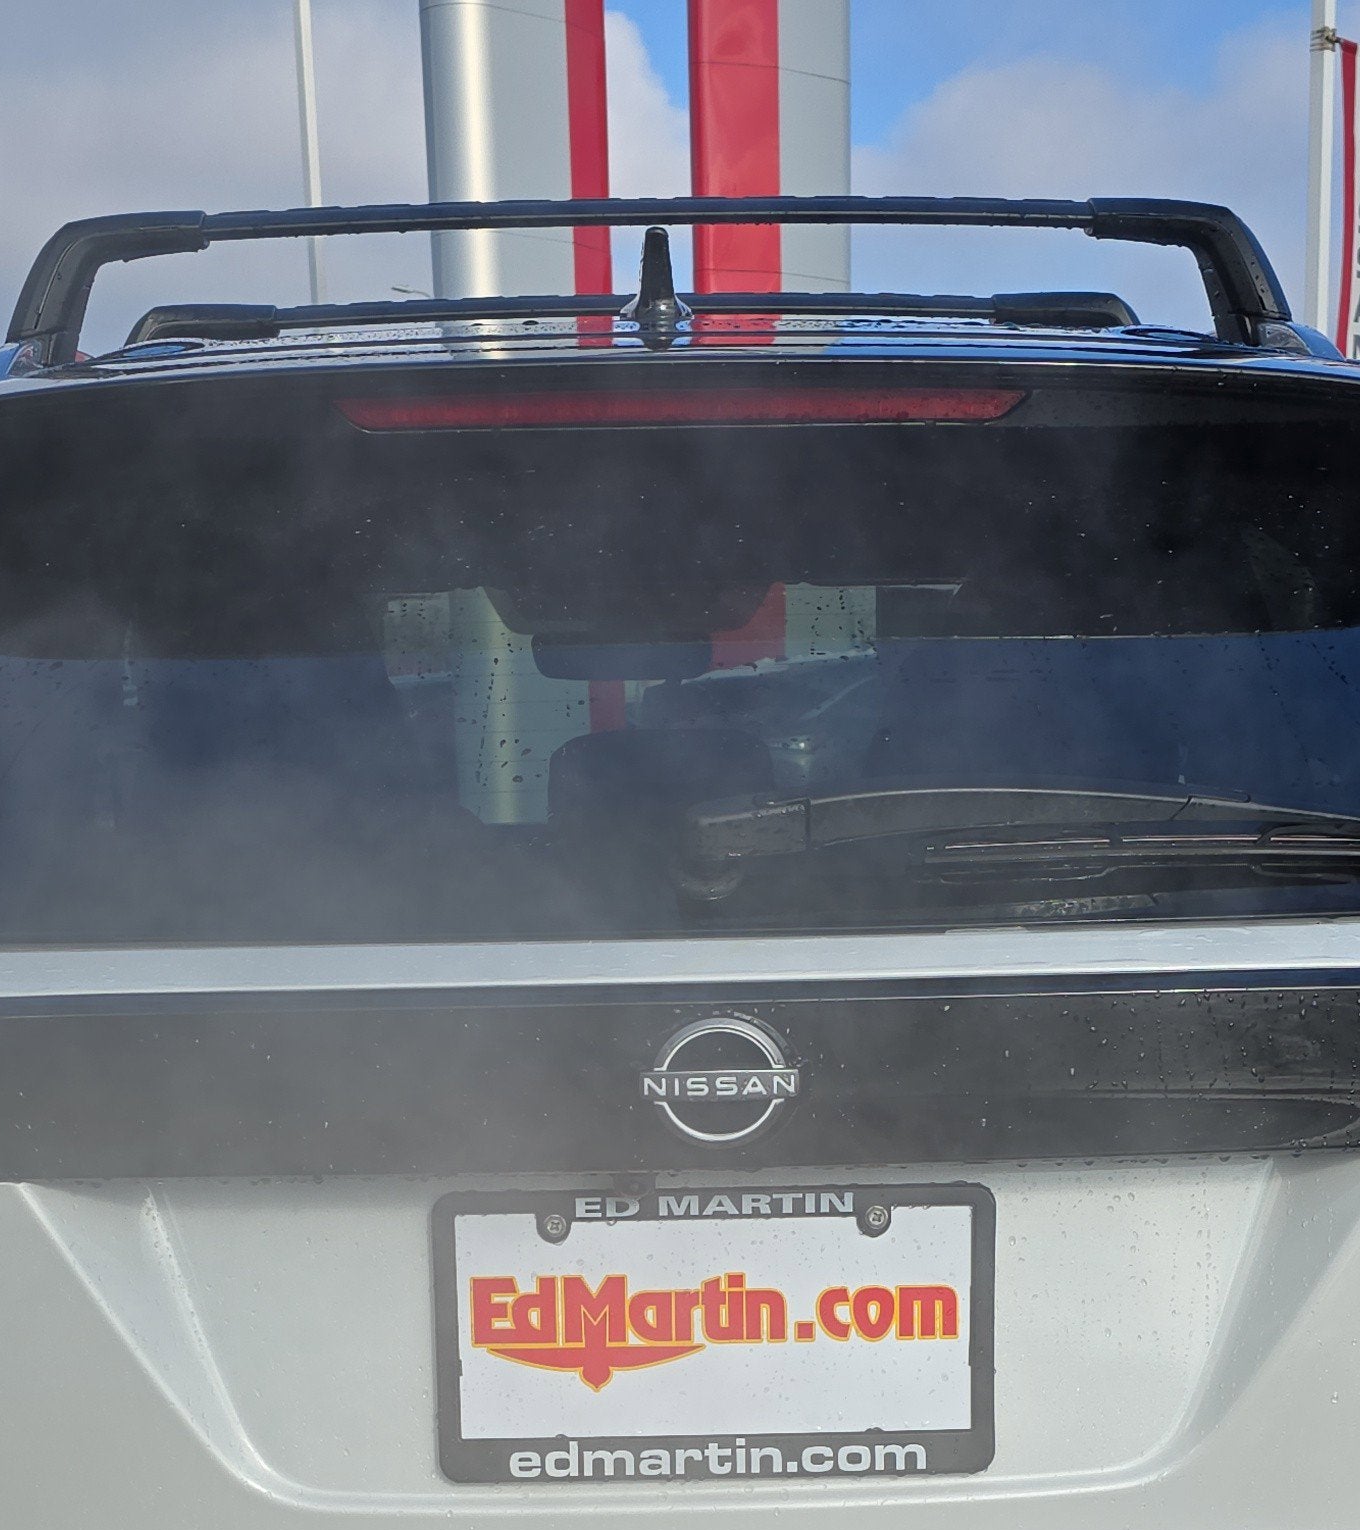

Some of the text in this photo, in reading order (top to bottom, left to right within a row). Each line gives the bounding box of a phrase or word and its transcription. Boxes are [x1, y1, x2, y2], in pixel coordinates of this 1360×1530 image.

[643, 1072, 797, 1098] NISSAN
[574, 1191, 855, 1219] ED MARTIN
[509, 1438, 928, 1479] edmartin.com
